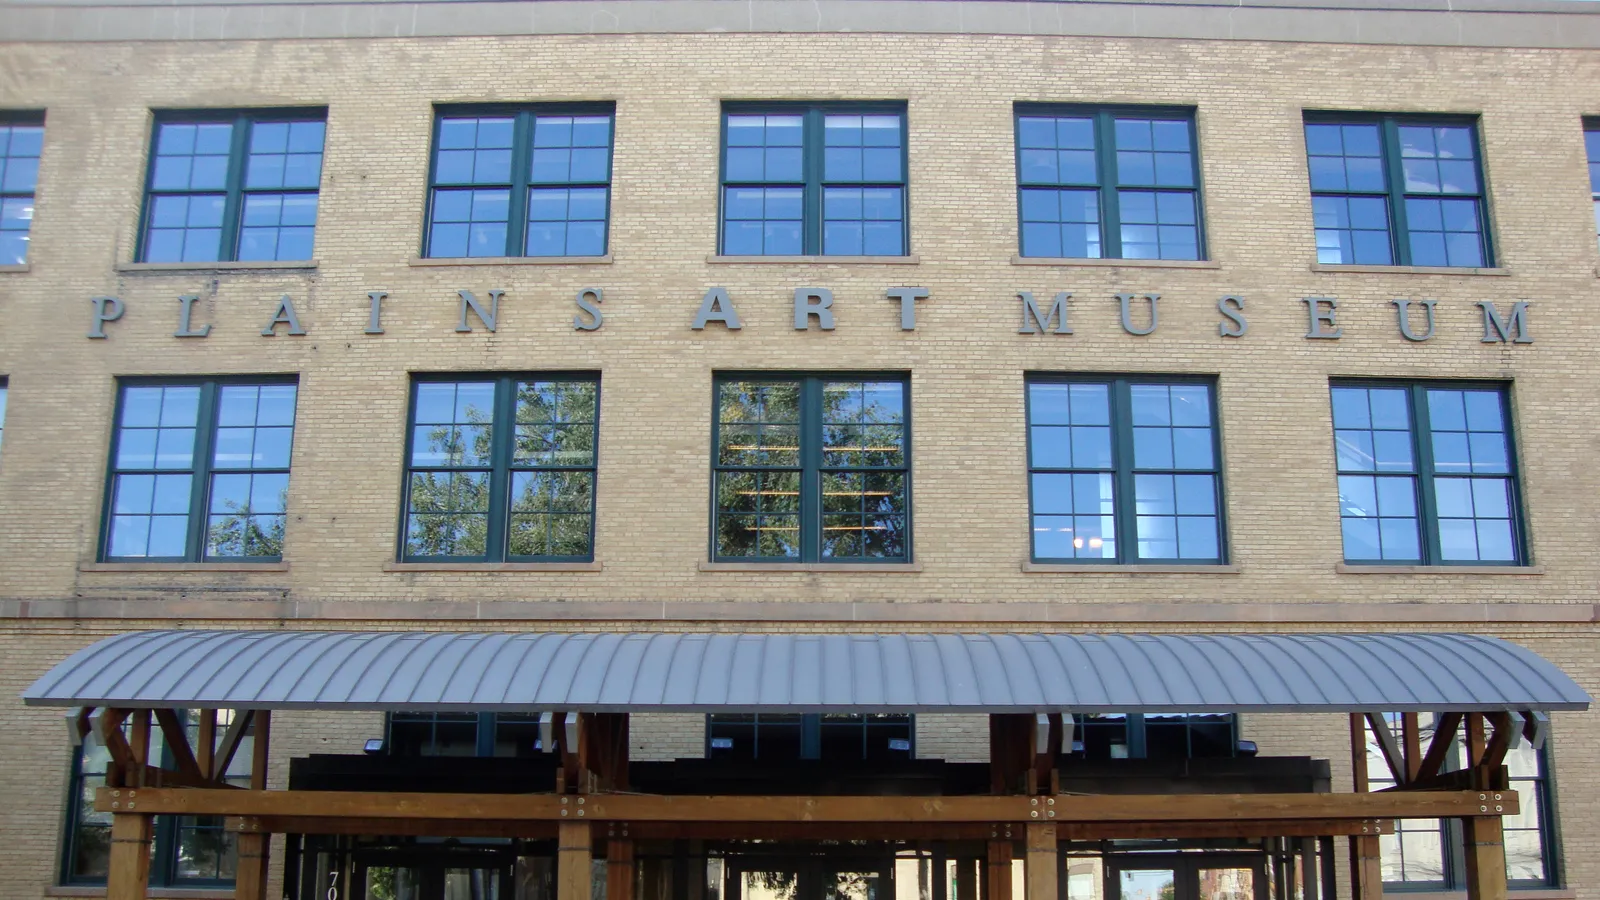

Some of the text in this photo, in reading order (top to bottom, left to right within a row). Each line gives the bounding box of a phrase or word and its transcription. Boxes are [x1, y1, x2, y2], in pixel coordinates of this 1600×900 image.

[86, 286, 1534, 345] PLAINS ART MUSEUM
